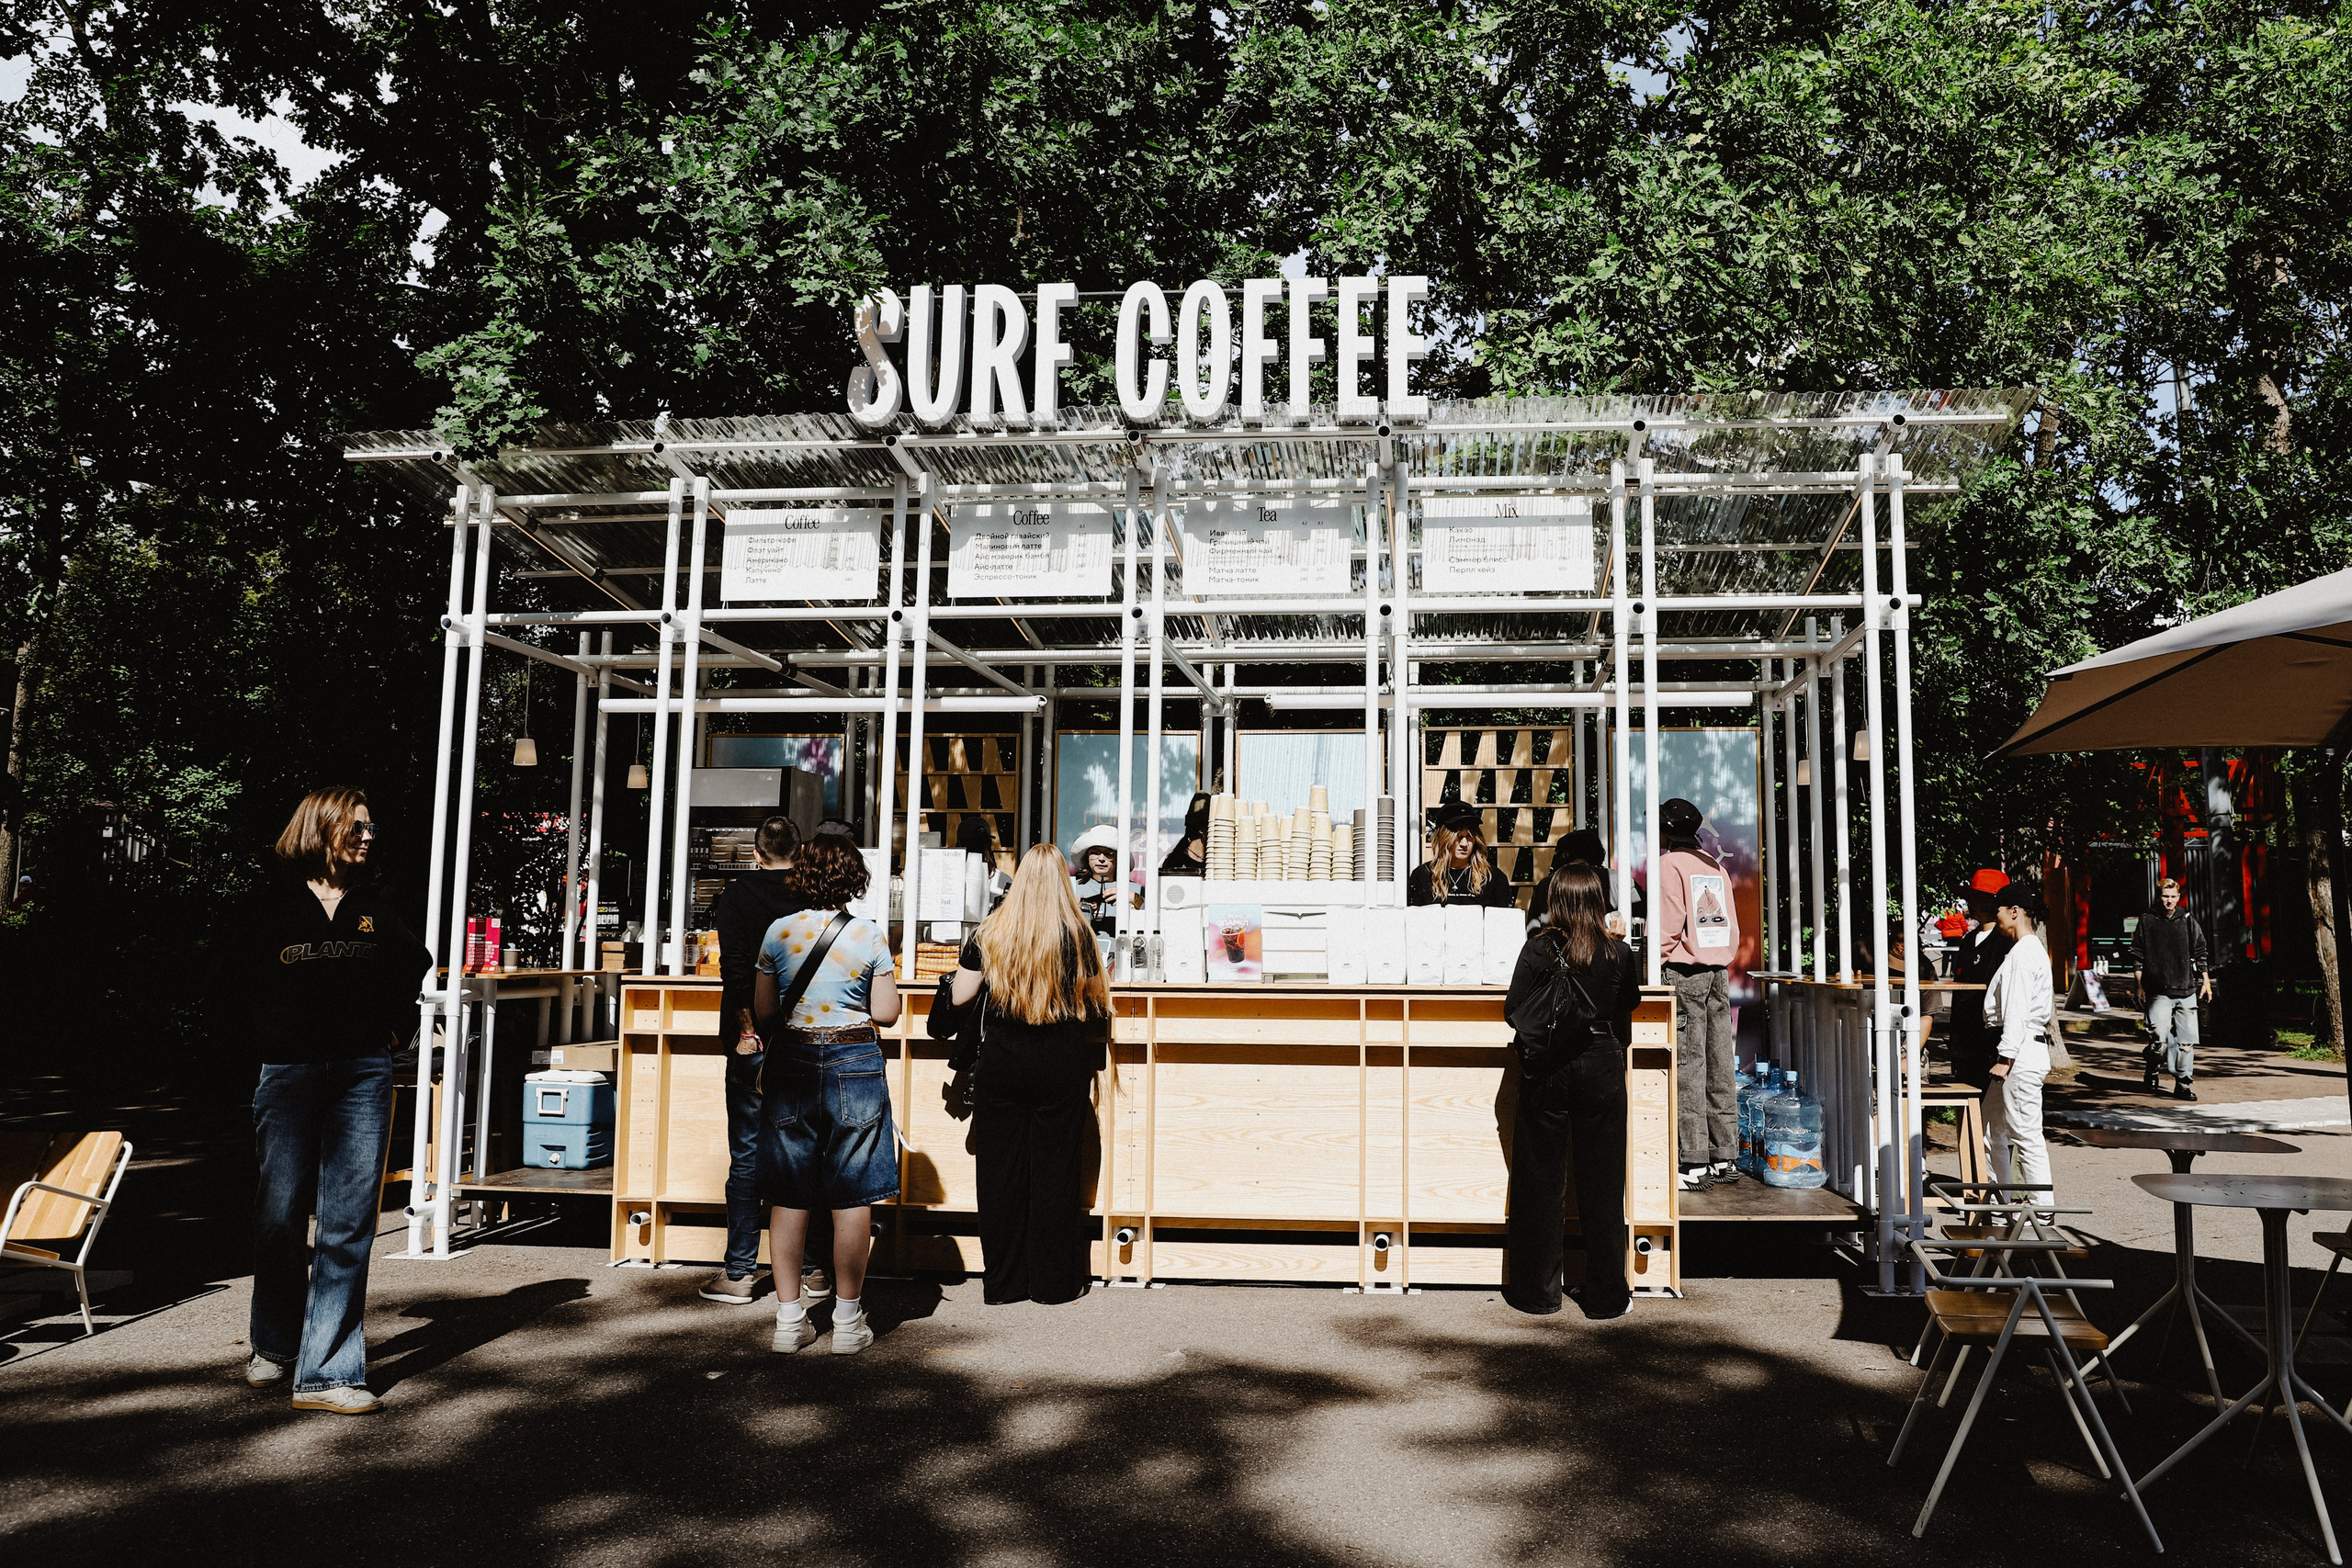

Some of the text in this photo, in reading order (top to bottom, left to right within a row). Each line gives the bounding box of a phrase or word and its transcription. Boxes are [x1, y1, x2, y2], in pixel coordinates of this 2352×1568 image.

[846, 276, 1428, 427] SURF COFFEE
[1257, 506, 1277, 522] Tea
[1495, 503, 1519, 518] Mix
[785, 514, 820, 530] Coffee
[1012, 510, 1050, 525] Coffee
[1209, 528, 1247, 536] Иван-чай
[1449, 525, 1474, 534] Какао
[747, 536, 797, 545] Фильтр-кофе
[975, 532, 1010, 540] Двойной
[1449, 536, 1486, 544] Лимонад
[975, 542, 1020, 550] Малиновый
[1209, 537, 1255, 547] Гречишный
[767, 546, 784, 555] уайт
[746, 557, 788, 565] Американо
[1449, 555, 1508, 564] Сэммер блисс
[1449, 566, 1476, 574] Перпл
[745, 576, 767, 584] Латте
[284, 941, 378, 964] PLANT
